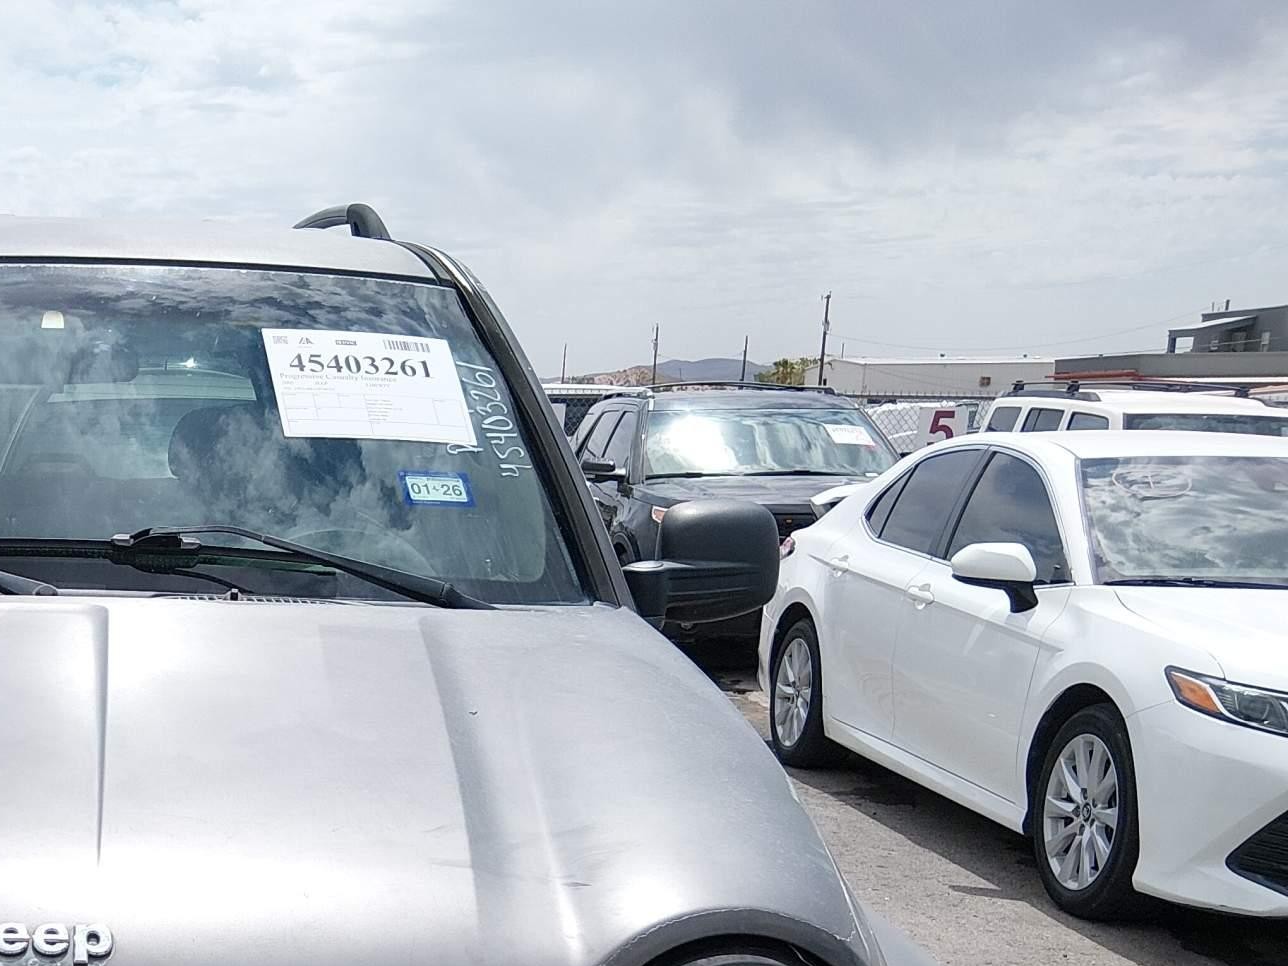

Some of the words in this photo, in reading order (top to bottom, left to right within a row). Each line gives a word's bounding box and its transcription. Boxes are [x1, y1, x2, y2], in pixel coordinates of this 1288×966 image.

[289, 353, 433, 379] 45403261
[455, 361, 533, 477] 45403261
[929, 410, 955, 440] 5
